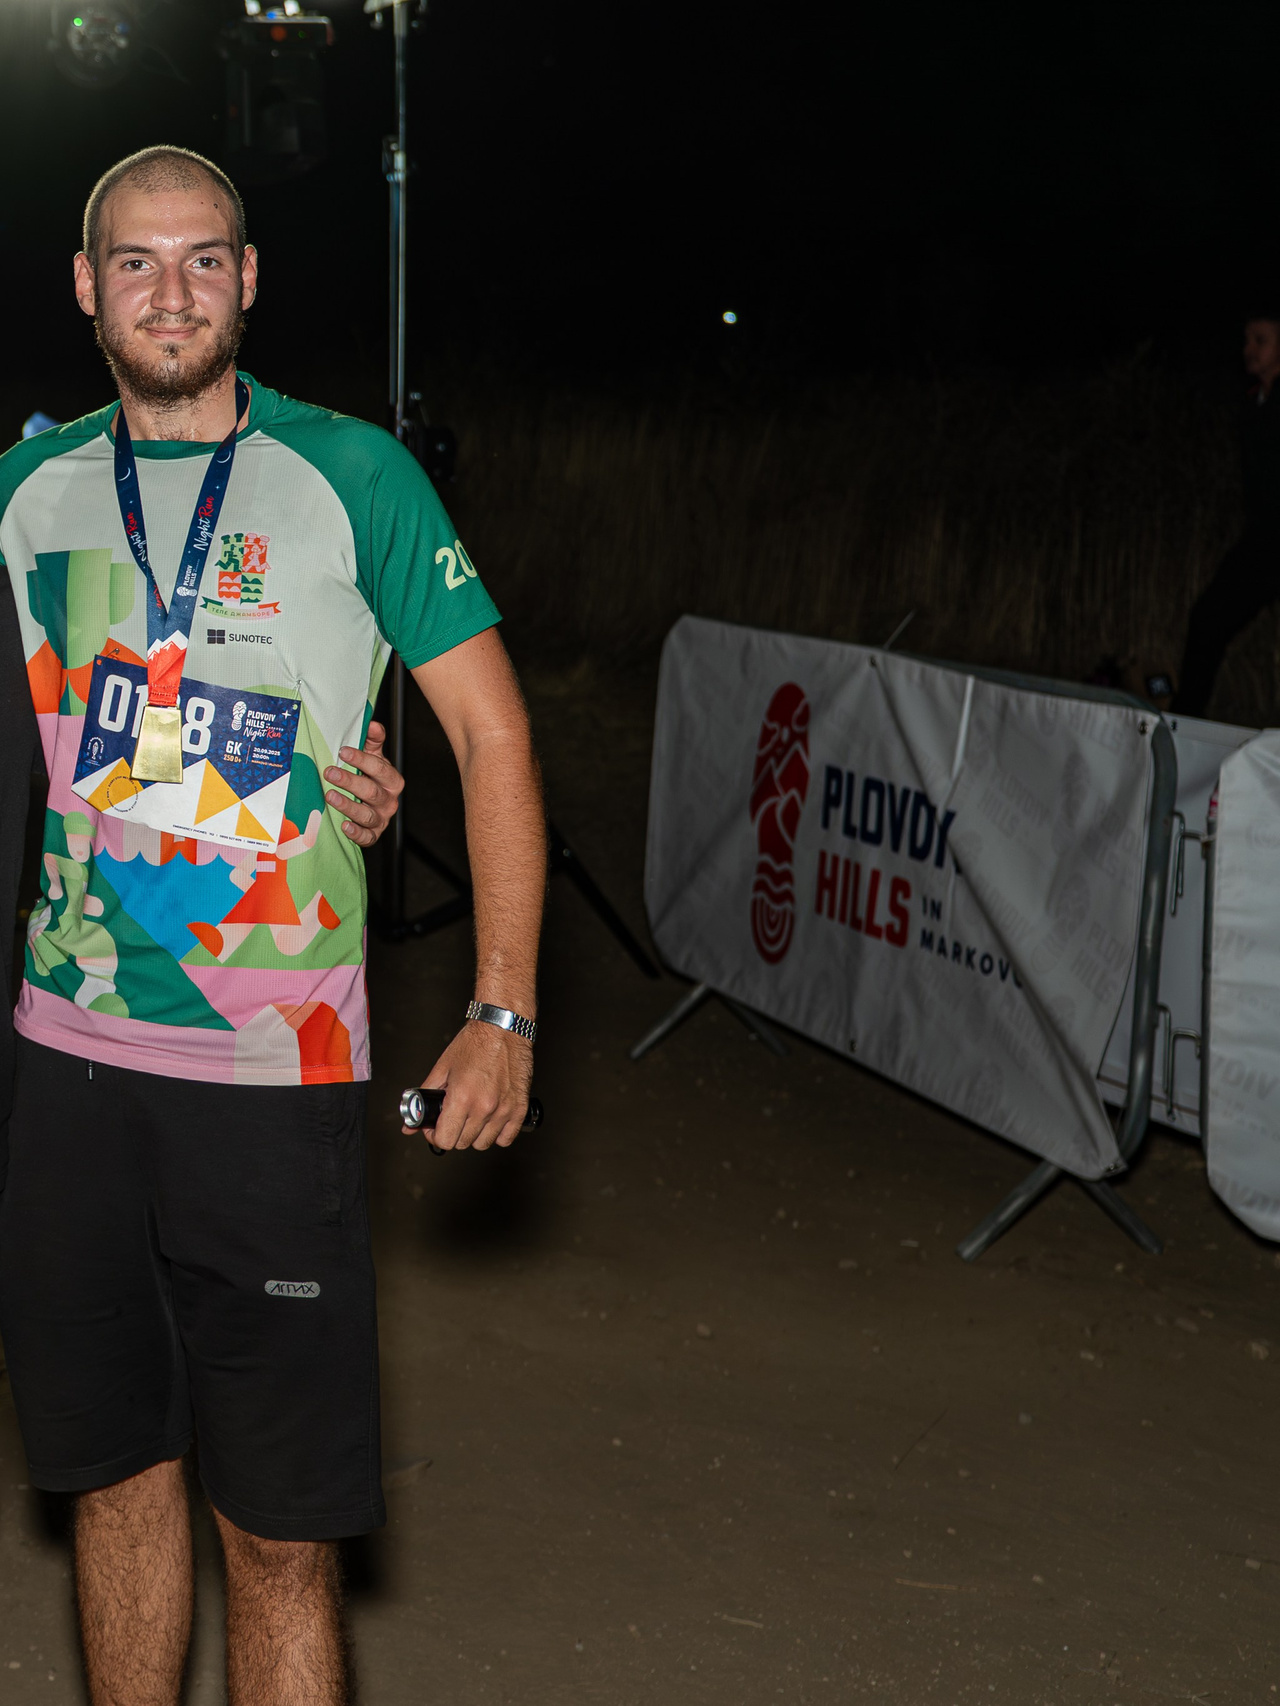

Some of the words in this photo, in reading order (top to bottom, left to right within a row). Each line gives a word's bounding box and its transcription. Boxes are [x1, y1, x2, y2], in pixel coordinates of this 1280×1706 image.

[198, 496, 214, 519] Run
[126, 512, 137, 536] Run
[193, 518, 213, 551] Night
[435, 539, 478, 590] 20
[229, 633, 273, 645] SUNOTEC
[98, 674, 216, 756] 018
[245, 718, 265, 729] HILLS
[247, 709, 276, 722] PLOVDIV
[243, 726, 267, 742] Night
[266, 727, 282, 739] Run
[225, 740, 243, 756] 6K
[815, 849, 912, 948] HILLS
[922, 896, 942, 922] IN
